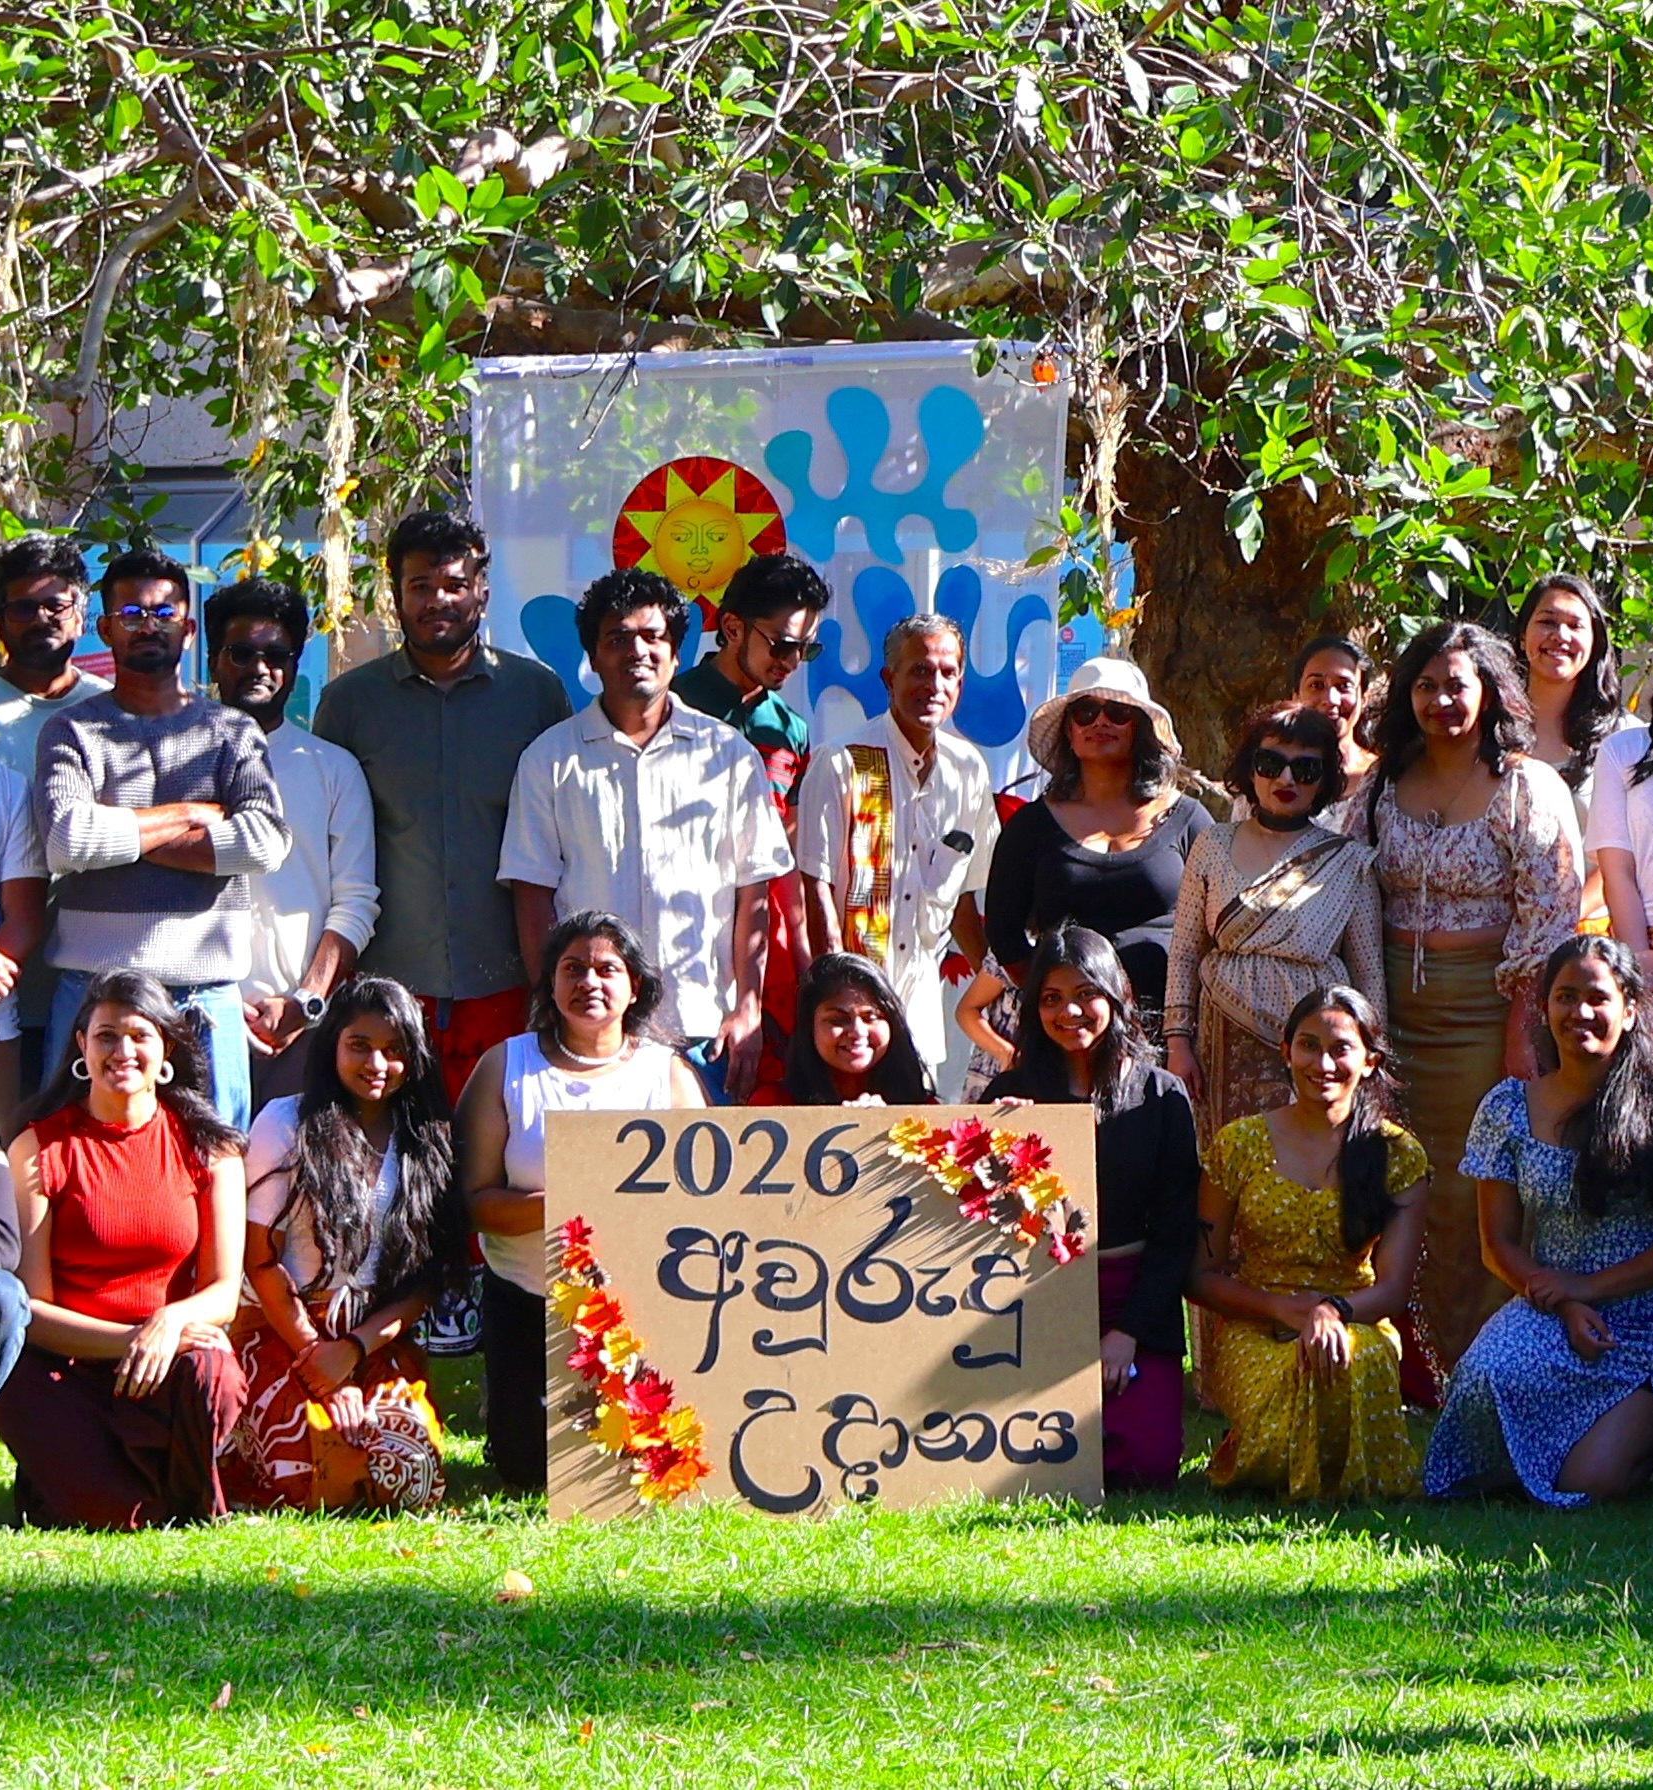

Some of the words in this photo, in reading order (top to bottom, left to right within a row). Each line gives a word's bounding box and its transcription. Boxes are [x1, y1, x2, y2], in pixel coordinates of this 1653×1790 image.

[615, 1118, 860, 1197] 2026
[657, 1196, 1023, 1374] අවුරුදු
[730, 1389, 1080, 1514] උදානය
